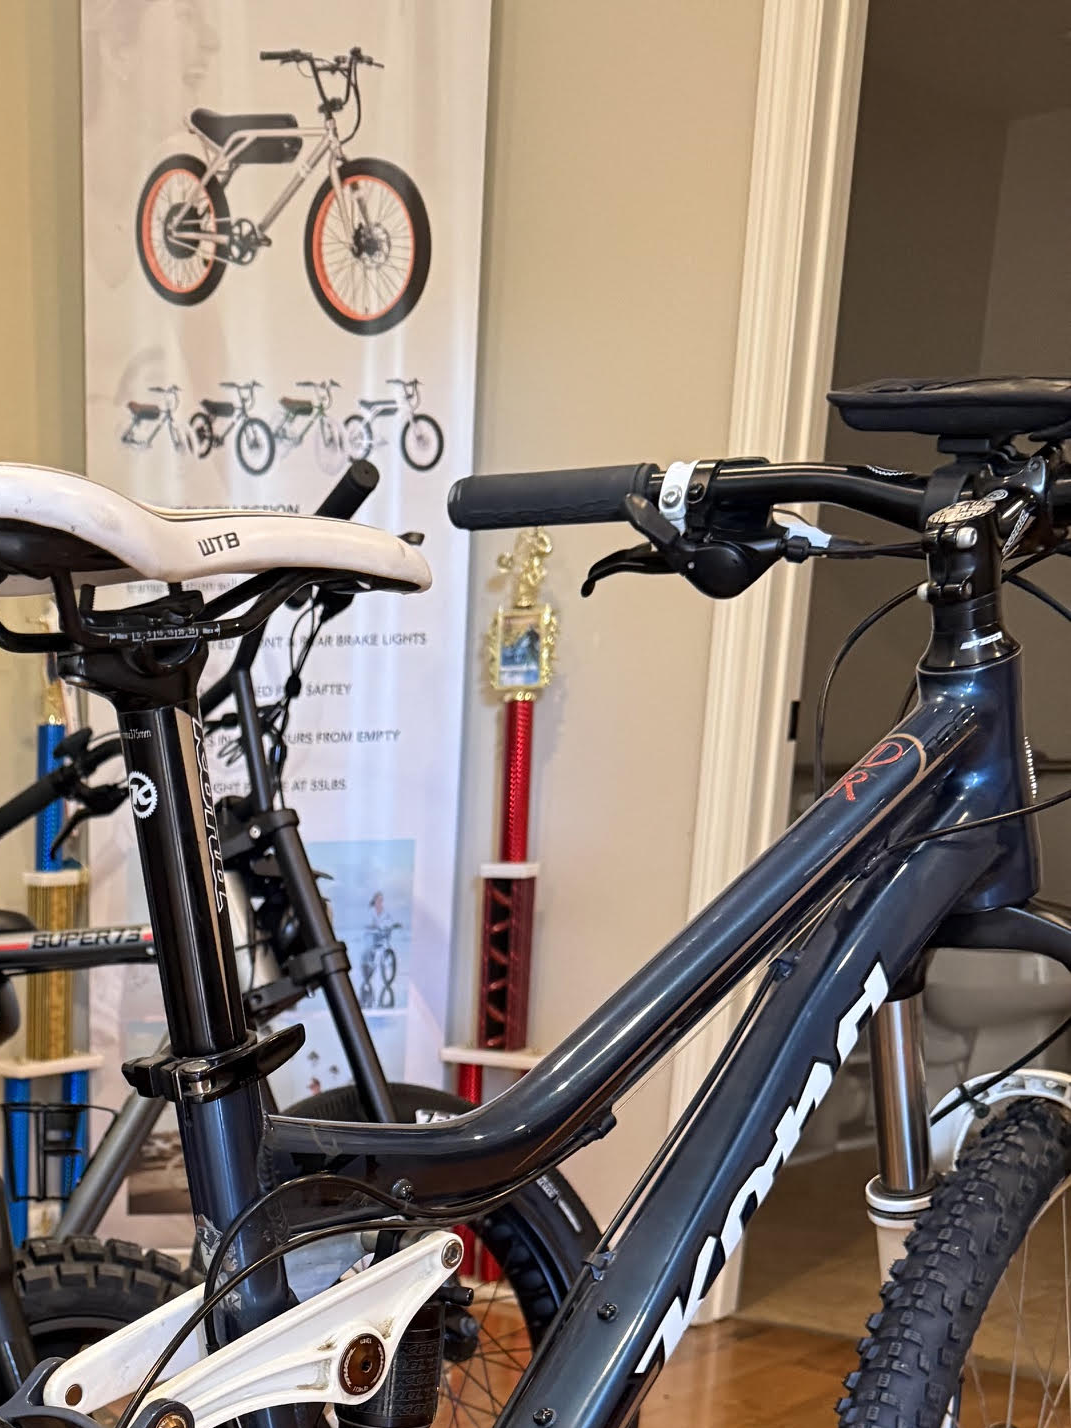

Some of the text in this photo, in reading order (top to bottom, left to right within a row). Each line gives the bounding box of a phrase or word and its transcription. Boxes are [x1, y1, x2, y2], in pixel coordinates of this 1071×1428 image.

[198, 531, 240, 557] WTB
[300, 633, 332, 648] RAR
[335, 633, 378, 648] BRAKE
[382, 632, 427, 647] LIGHTS
[305, 684, 352, 696] SAFTEY
[287, 731, 313, 744] URS
[316, 731, 352, 743] FROM
[356, 729, 401, 742] EMPTY
[292, 779, 307, 791] AT
[32, 927, 141, 950] SUPER73
